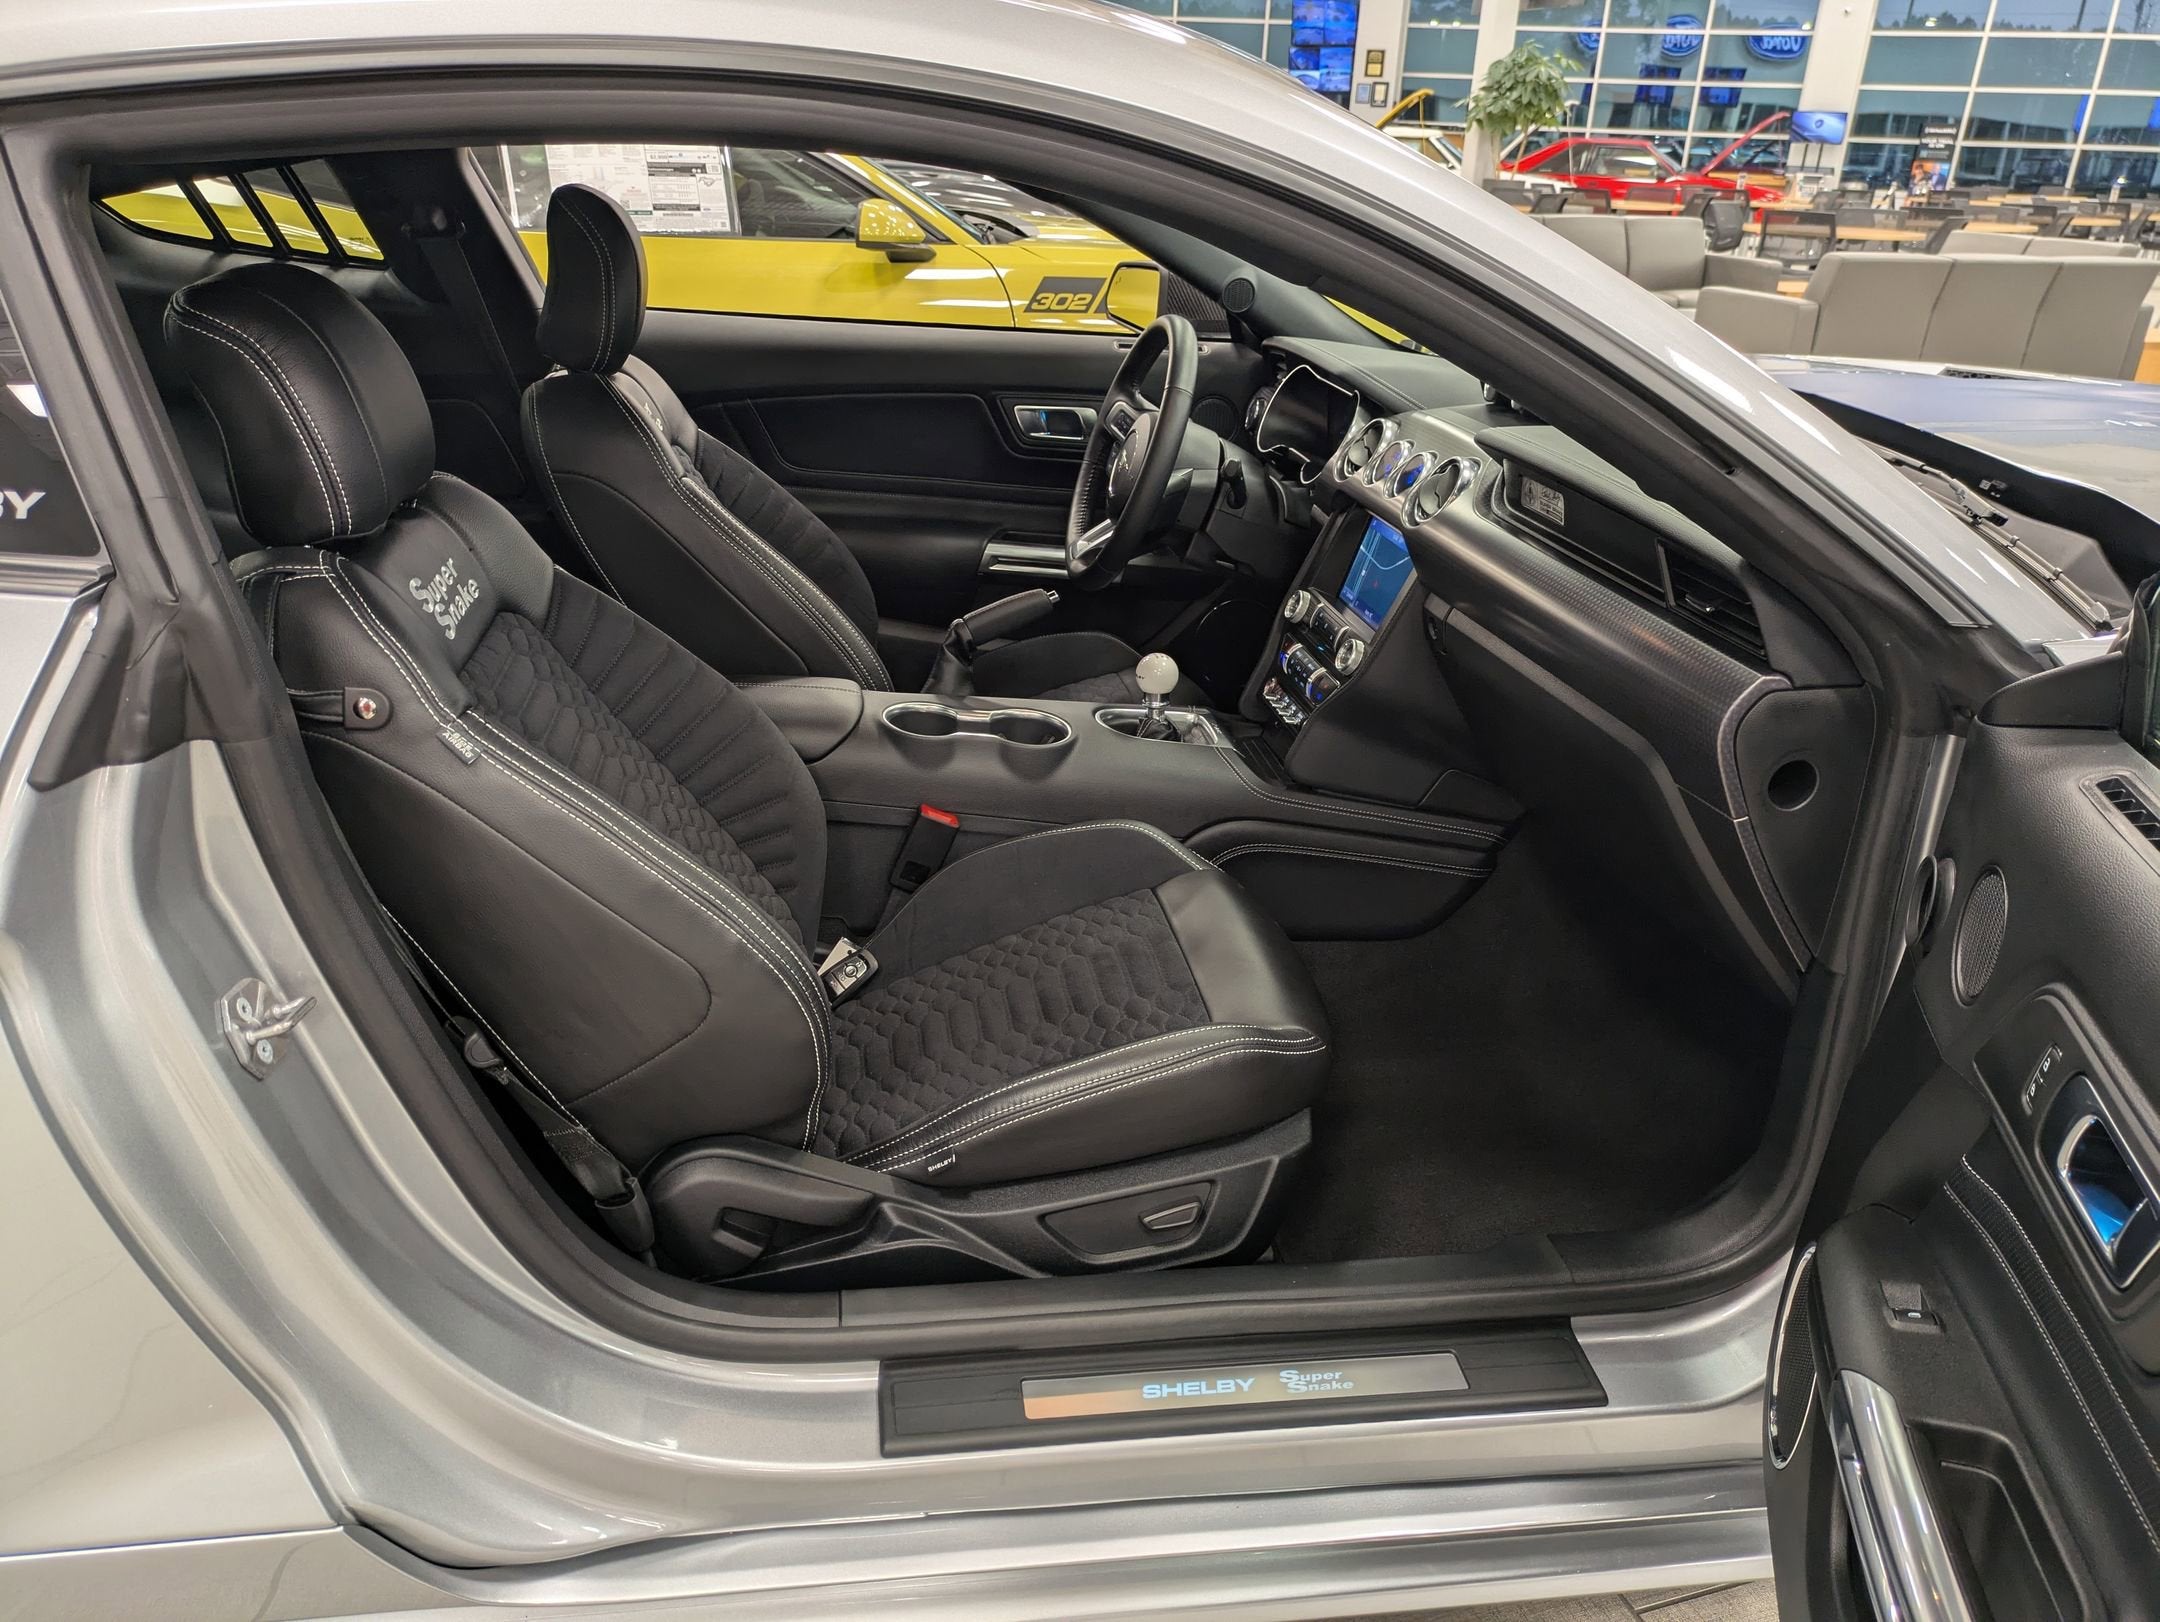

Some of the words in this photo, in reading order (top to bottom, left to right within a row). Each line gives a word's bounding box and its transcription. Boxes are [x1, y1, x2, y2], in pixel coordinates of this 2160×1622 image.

[1031, 292, 1093, 311] 302
[409, 557, 458, 613] Super
[434, 578, 480, 640] Snake
[927, 1157, 952, 1172] SHELBY
[1279, 1369, 1343, 1384] Super
[1142, 1377, 1256, 1399] SHELBY
[1286, 1380, 1354, 1394] Snake
